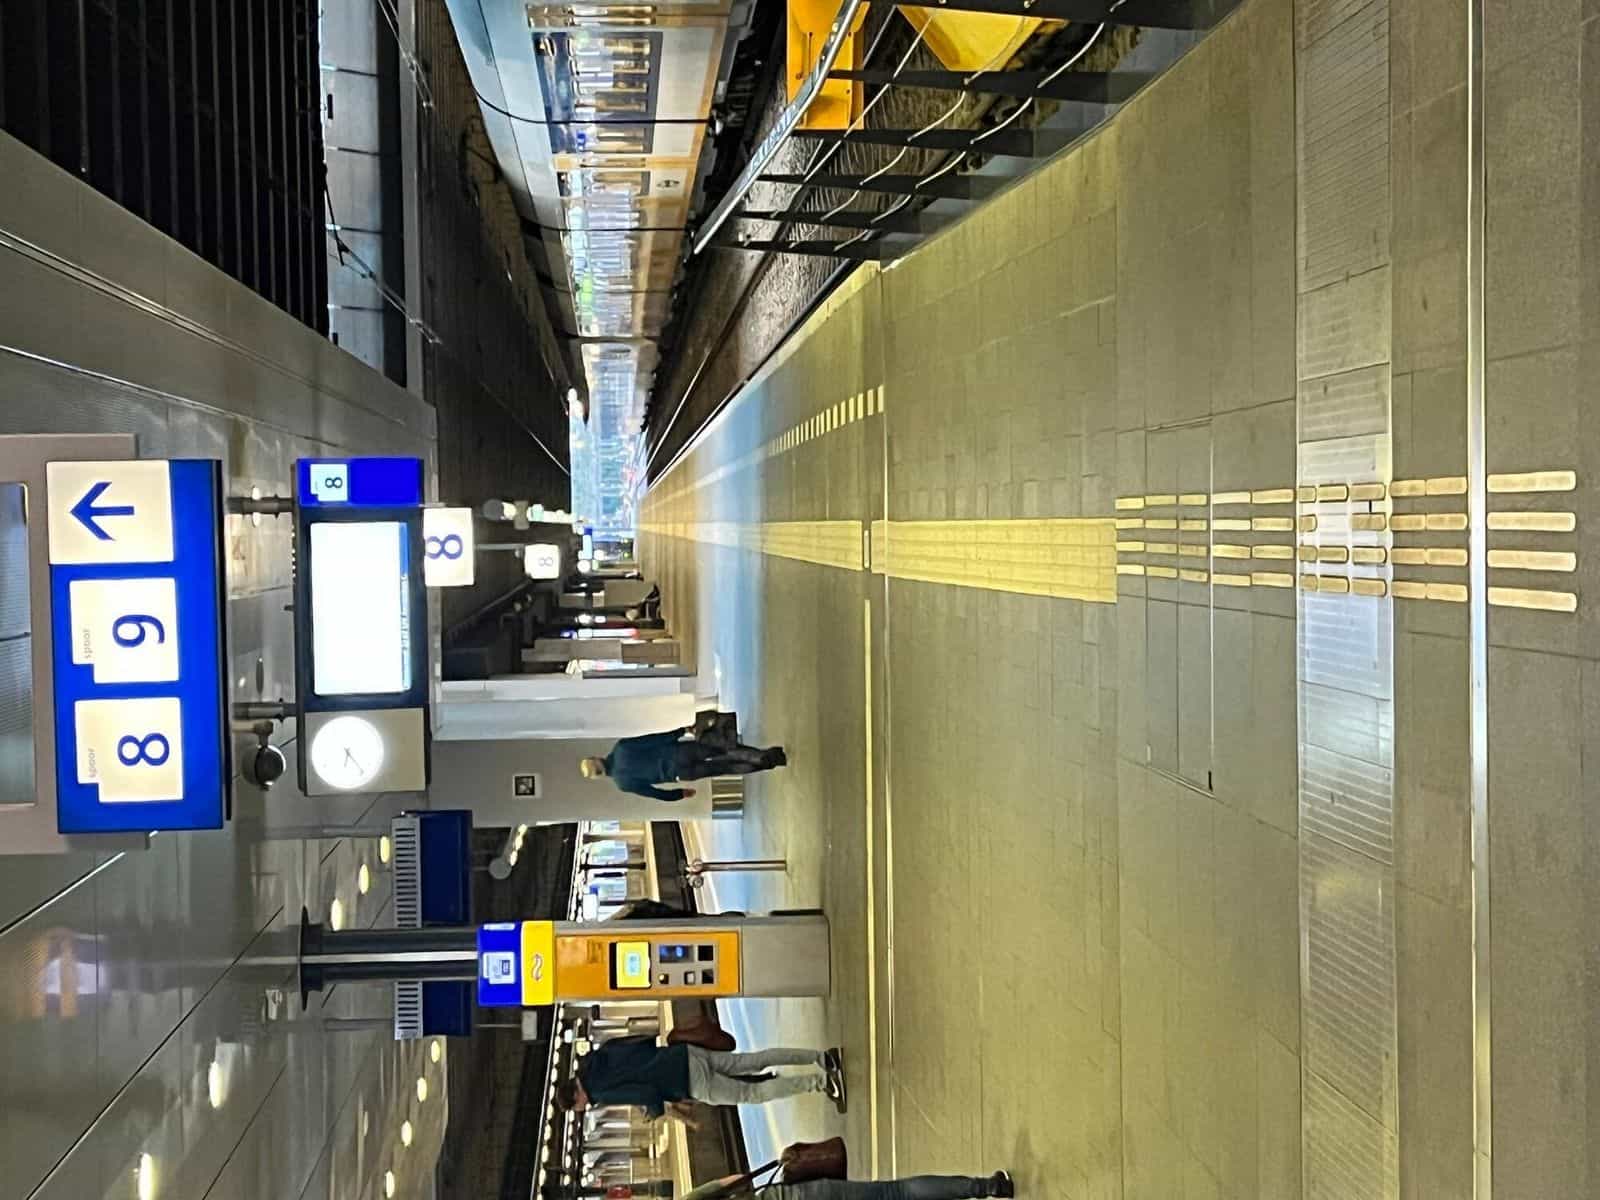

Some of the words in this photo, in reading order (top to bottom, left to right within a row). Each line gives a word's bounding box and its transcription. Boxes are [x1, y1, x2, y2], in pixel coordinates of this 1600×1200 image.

[324, 477, 343, 489] 8
[424, 534, 463, 560] 8
[537, 556, 553, 568] 8
[112, 614, 165, 649] 9
[117, 733, 170, 767] 8
